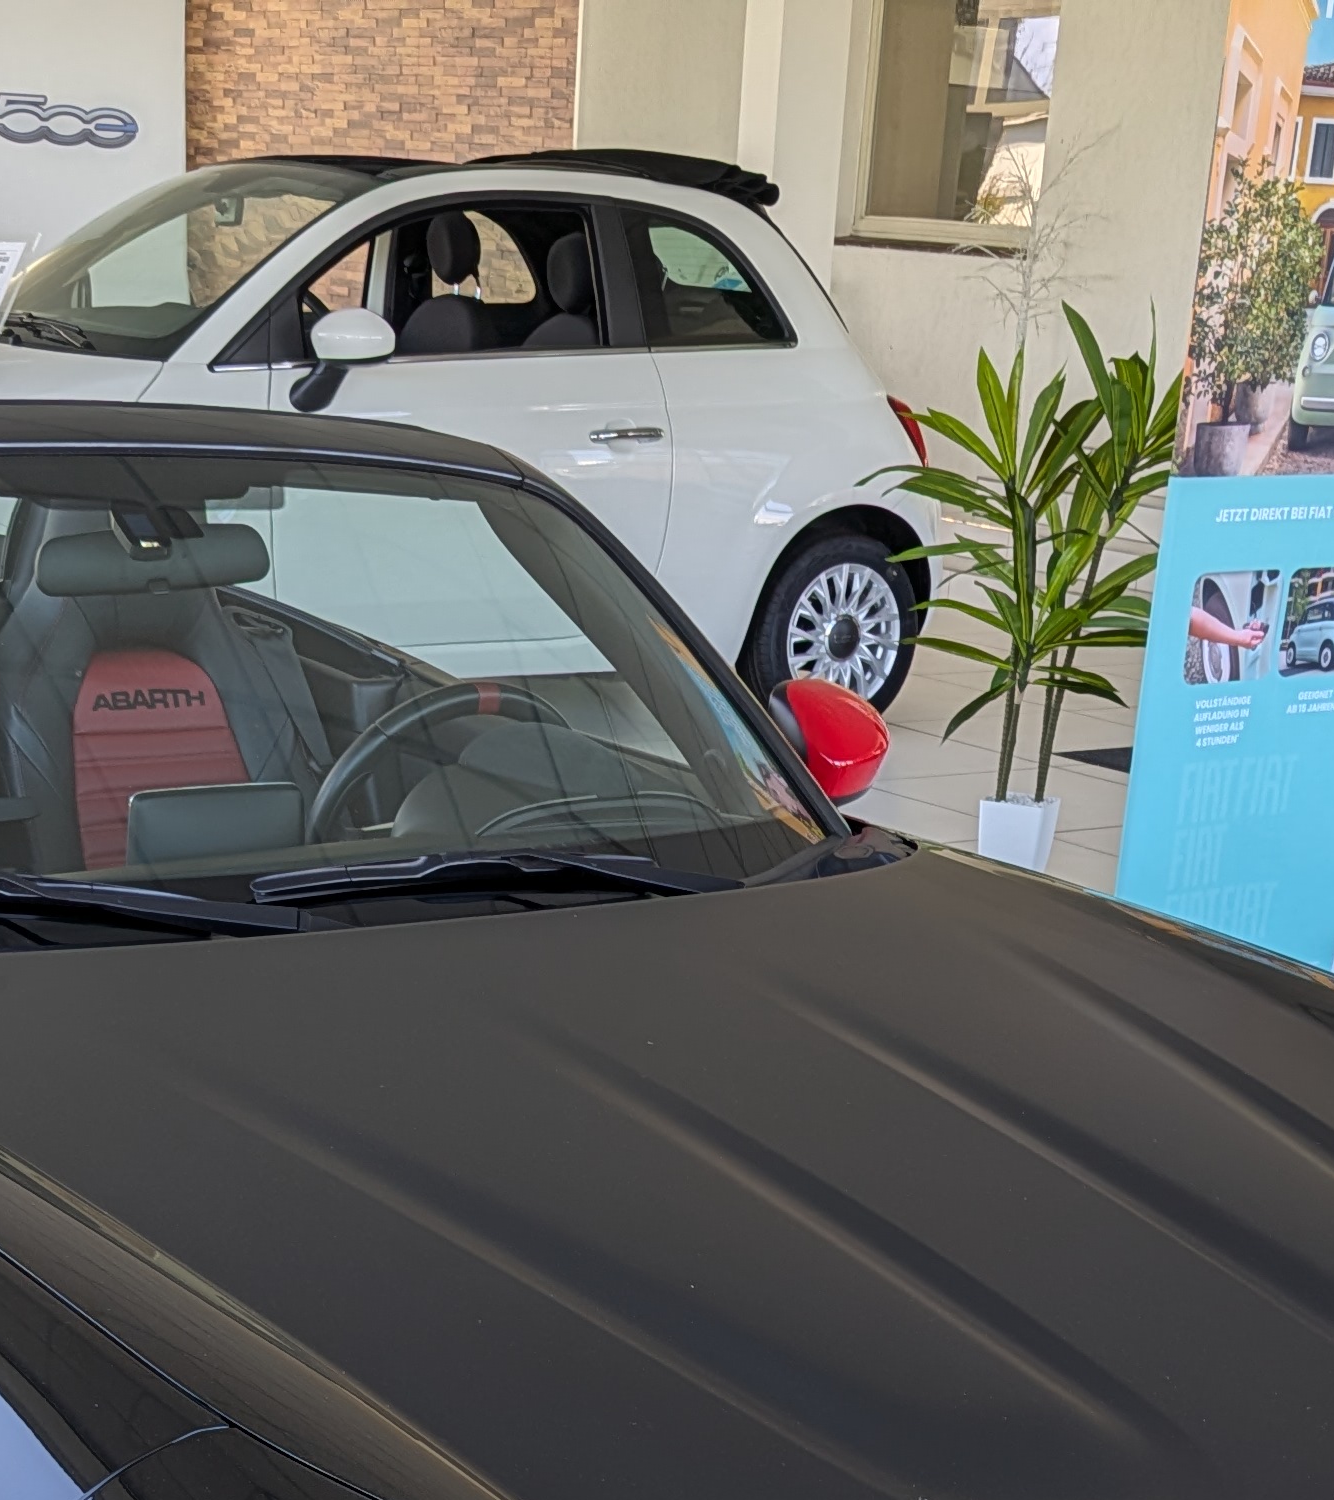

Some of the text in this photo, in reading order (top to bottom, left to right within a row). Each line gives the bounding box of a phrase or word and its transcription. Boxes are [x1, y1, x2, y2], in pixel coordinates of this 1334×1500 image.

[1216, 508, 1249, 523] JETZT
[1250, 507, 1290, 521] DIREKT
[1290, 506, 1308, 520] BEI
[1308, 506, 1332, 519] FIAT
[93, 689, 205, 711] ABARTH
[1195, 695, 1252, 709] VOLLSTÄNDIGE
[1298, 689, 1334, 701] GEEIGNET
[1193, 708, 1240, 722] AUFLADUNG
[1195, 720, 1245, 735] WENIGER ALS
